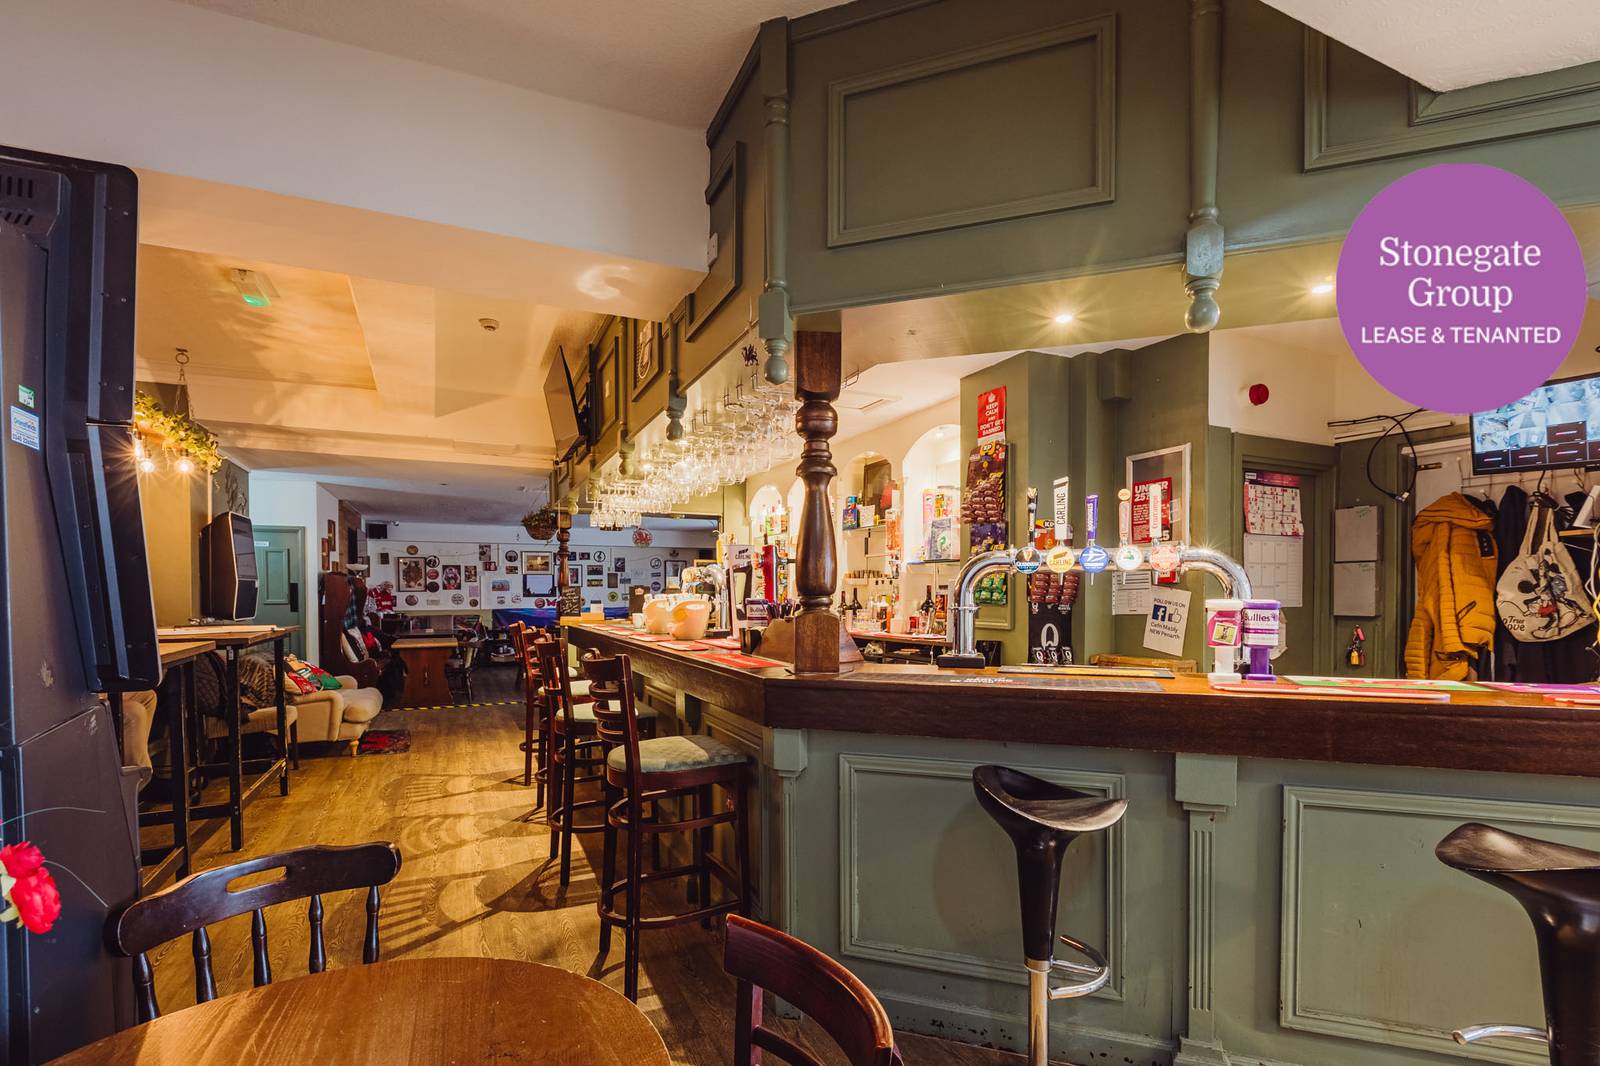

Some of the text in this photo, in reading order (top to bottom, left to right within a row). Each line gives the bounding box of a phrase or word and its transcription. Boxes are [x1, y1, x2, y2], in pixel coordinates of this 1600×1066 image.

[985, 407, 998, 417] CALM
[1135, 480, 1168, 494] UNR
[1056, 492, 1066, 526] CARLING
[1160, 529, 1170, 541] 5
[1154, 597, 1171, 606] FOLLOW
[1508, 615, 1525, 624] True
